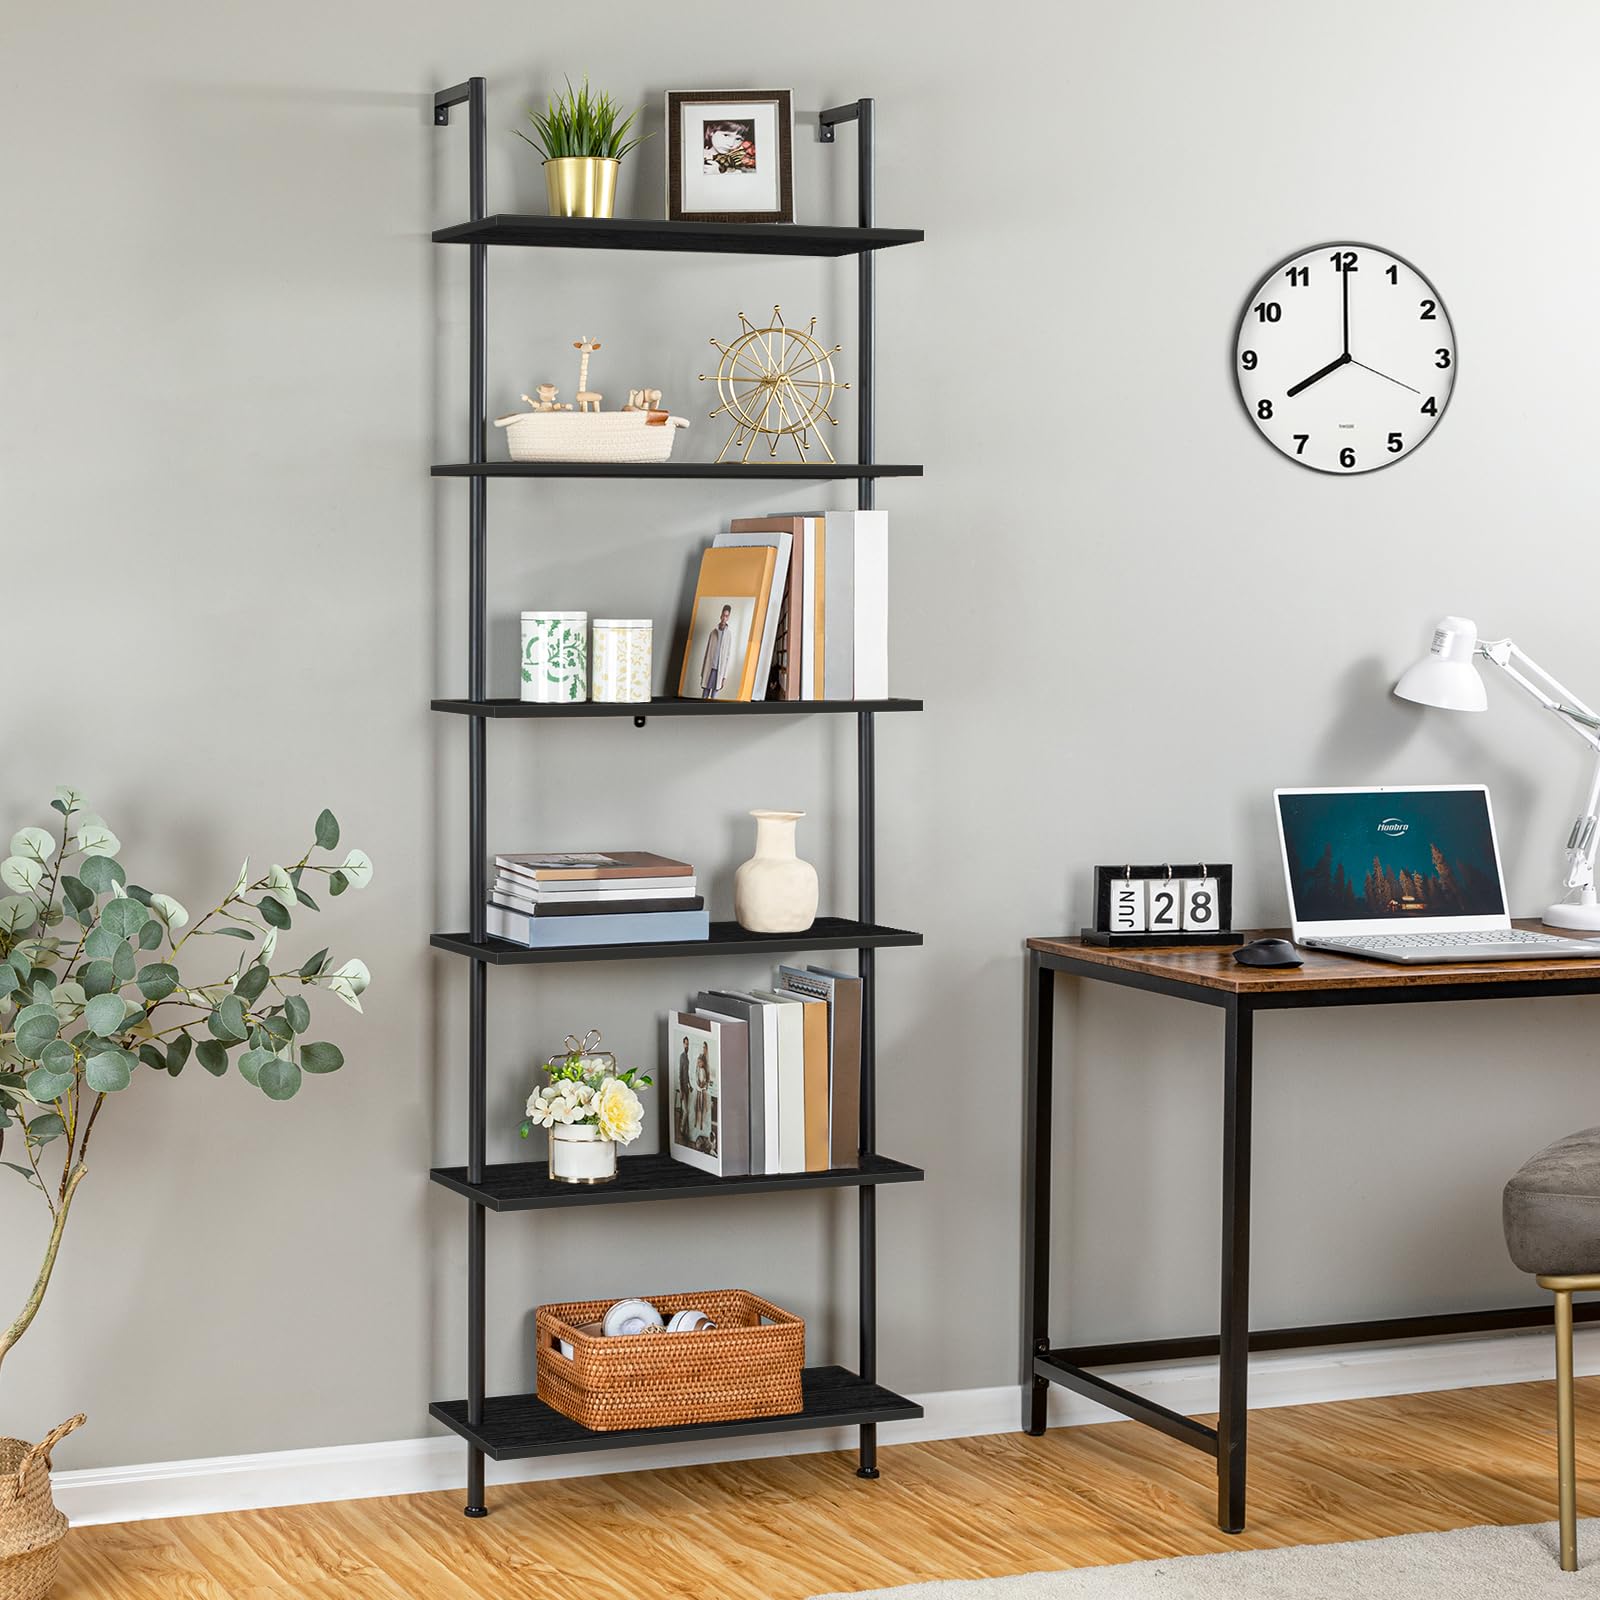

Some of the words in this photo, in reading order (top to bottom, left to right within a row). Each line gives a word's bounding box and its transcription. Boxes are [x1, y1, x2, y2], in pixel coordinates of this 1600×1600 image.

[1330, 252, 1358, 272] 12
[1285, 267, 1309, 287] 11
[1385, 265, 1398, 285] 1
[1254, 302, 1282, 323] 10
[1420, 300, 1437, 320] 2
[1241, 350, 1258, 370] 9
[1434, 348, 1451, 369] 3
[1257, 399, 1273, 420] 8
[1420, 396, 1438, 417] 4
[1293, 434, 1309, 454] 7
[1387, 432, 1404, 453] 5
[1339, 448, 1356, 468] 6
[1119, 891, 1135, 927] JUN
